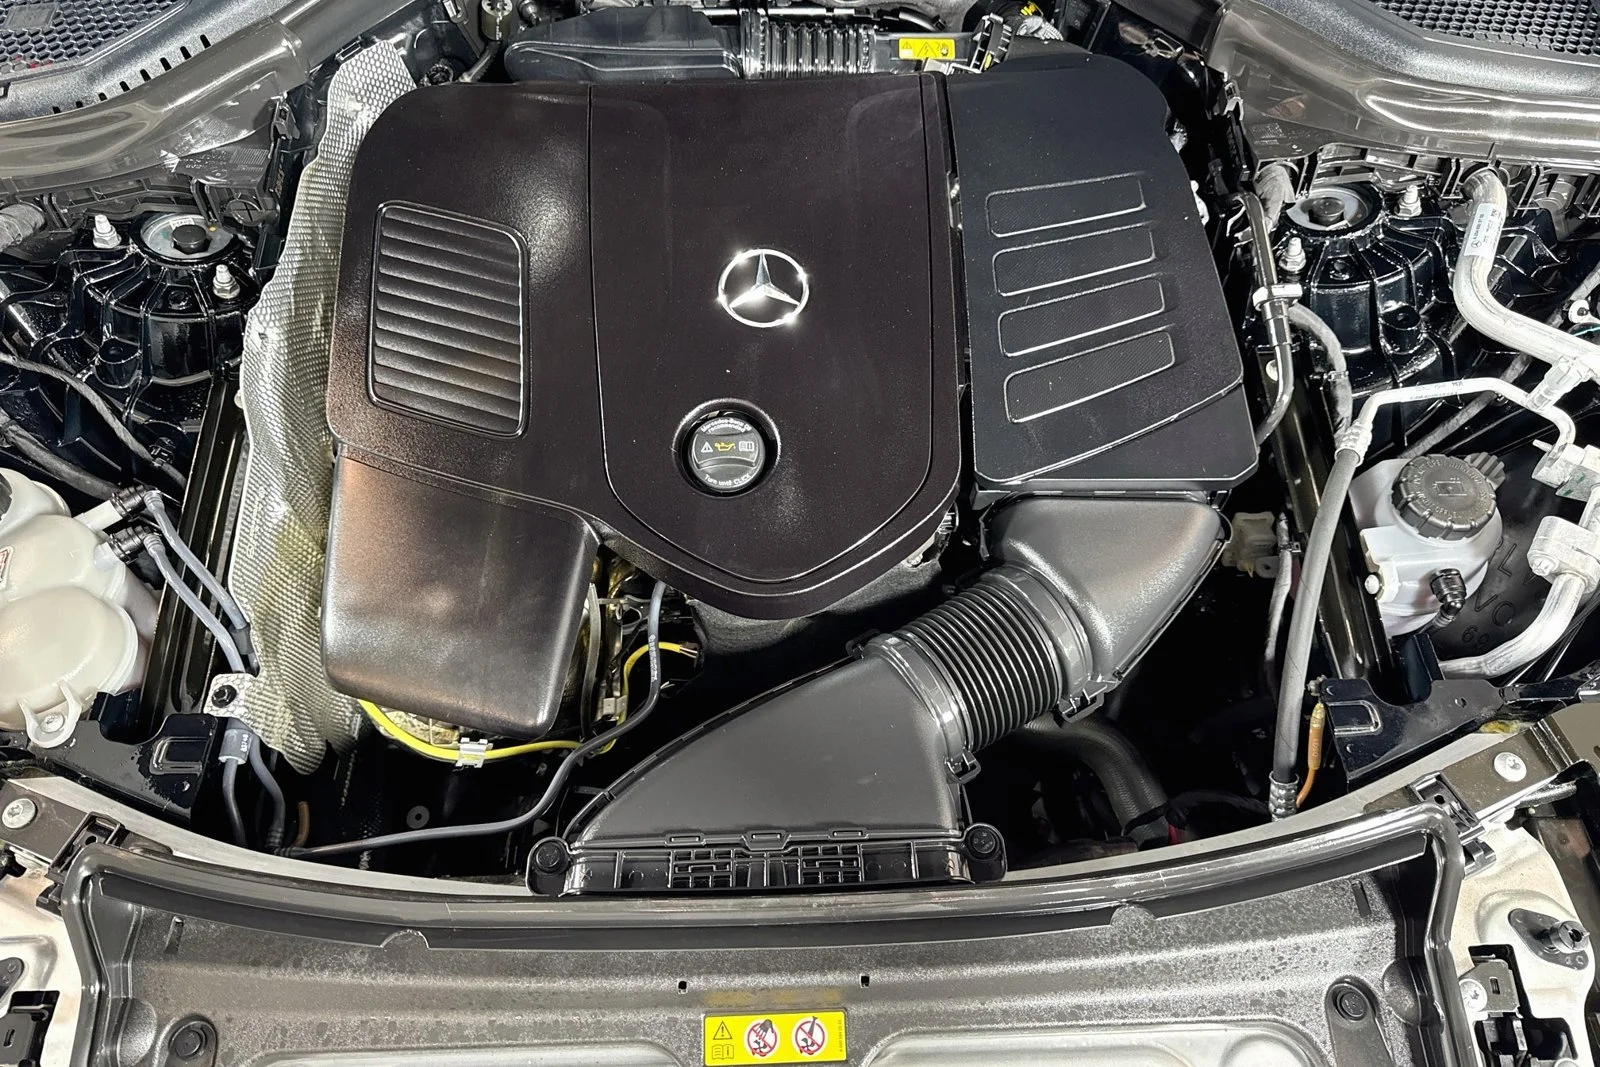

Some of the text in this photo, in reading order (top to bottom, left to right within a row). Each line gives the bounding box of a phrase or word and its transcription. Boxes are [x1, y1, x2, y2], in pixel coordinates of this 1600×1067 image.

[701, 418, 744, 432] Mercedes-Benz
[708, 423, 746, 433] recommended
[704, 473, 717, 485] Turn
[734, 473, 751, 484] CLICK
